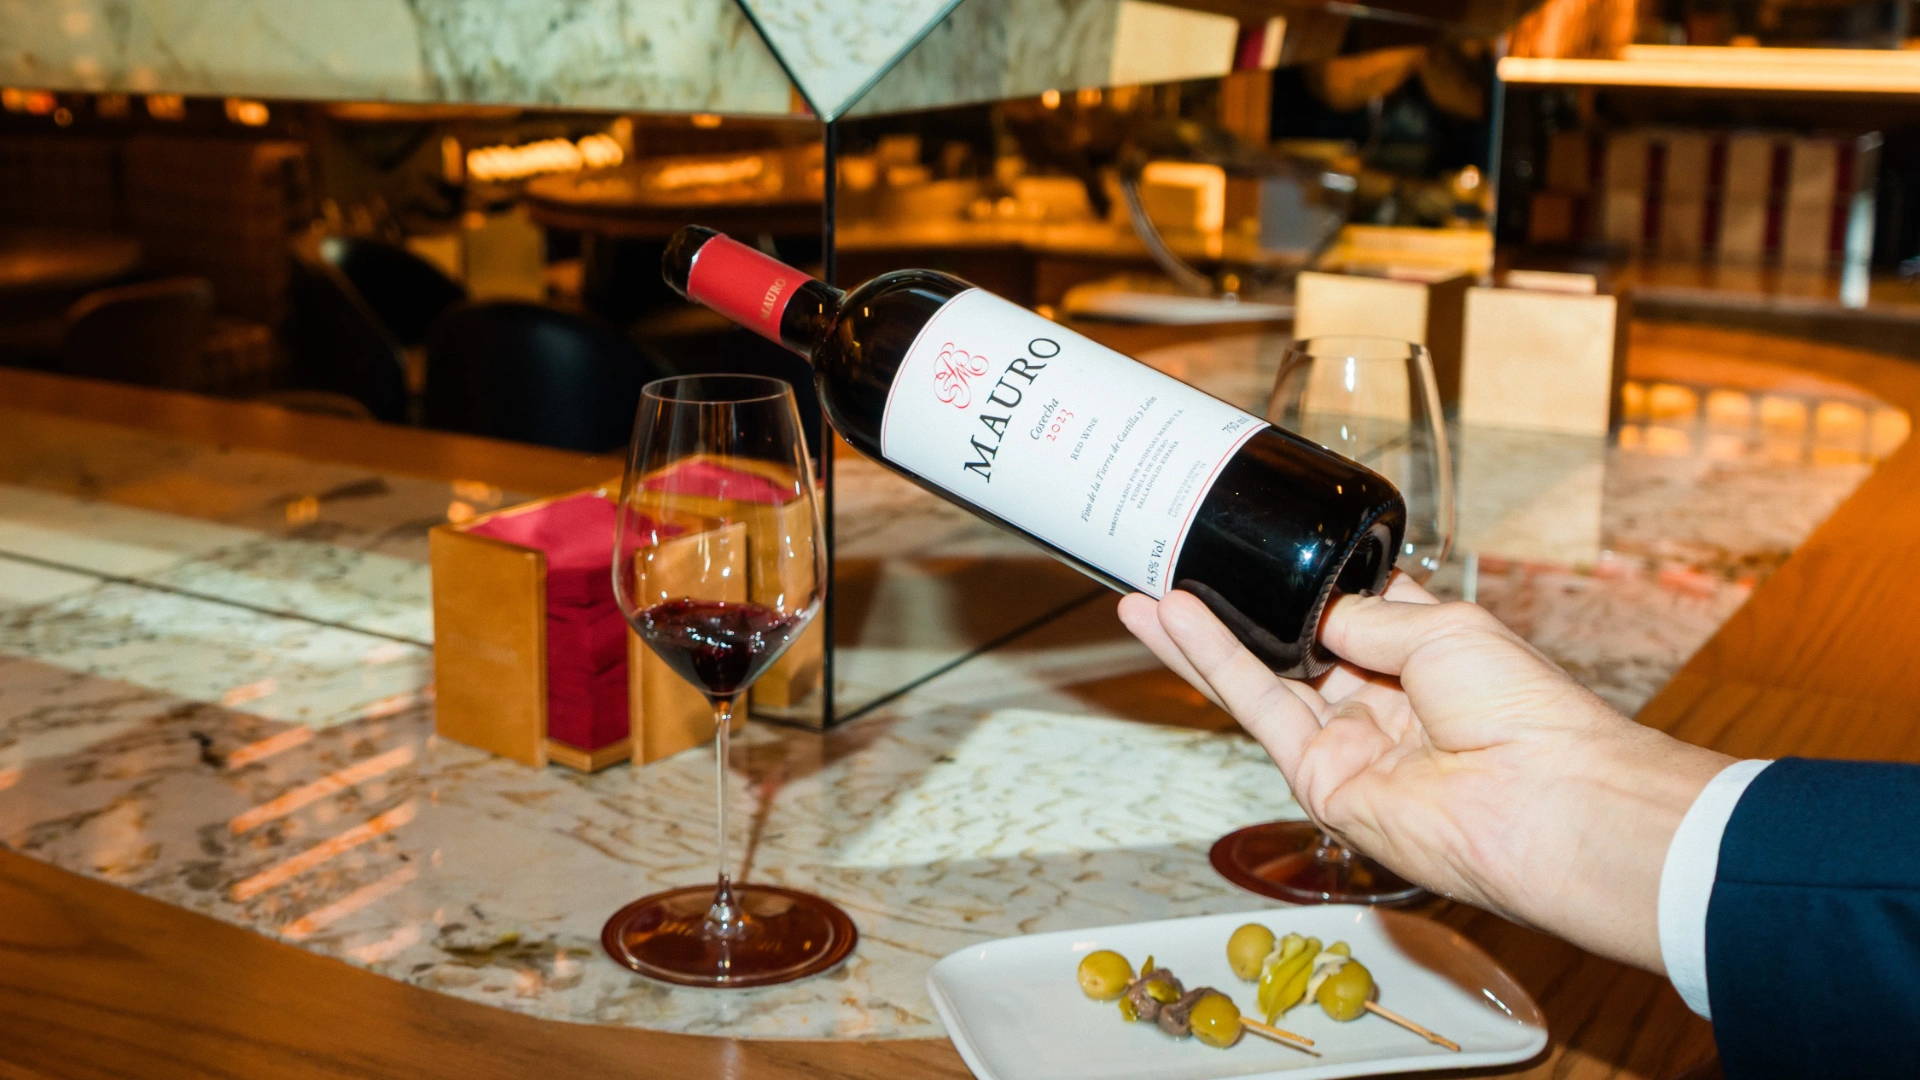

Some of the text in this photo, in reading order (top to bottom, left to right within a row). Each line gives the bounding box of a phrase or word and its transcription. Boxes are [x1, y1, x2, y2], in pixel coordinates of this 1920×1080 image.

[963, 337, 1061, 483] MAURO
[1030, 398, 1060, 440] Cosecha
[1046, 408, 1075, 442] 2023
[1222, 421, 1240, 433] 750
[1070, 416, 1099, 461] RED WINE
[1081, 396, 1158, 523] Vino de la Tierra de Castilla y León
[1108, 483, 1132, 537] EMBOTELLADO
[1129, 467, 1140, 482] POR
[1137, 437, 1160, 467] BODEGAS
[1157, 416, 1176, 436] MAURO
[1131, 439, 1168, 501] TUDELA DE DUERO
[1136, 440, 1180, 509] VALLADOLID ESPAÑA
[1147, 539, 1167, 587] 14.5% Vol.
